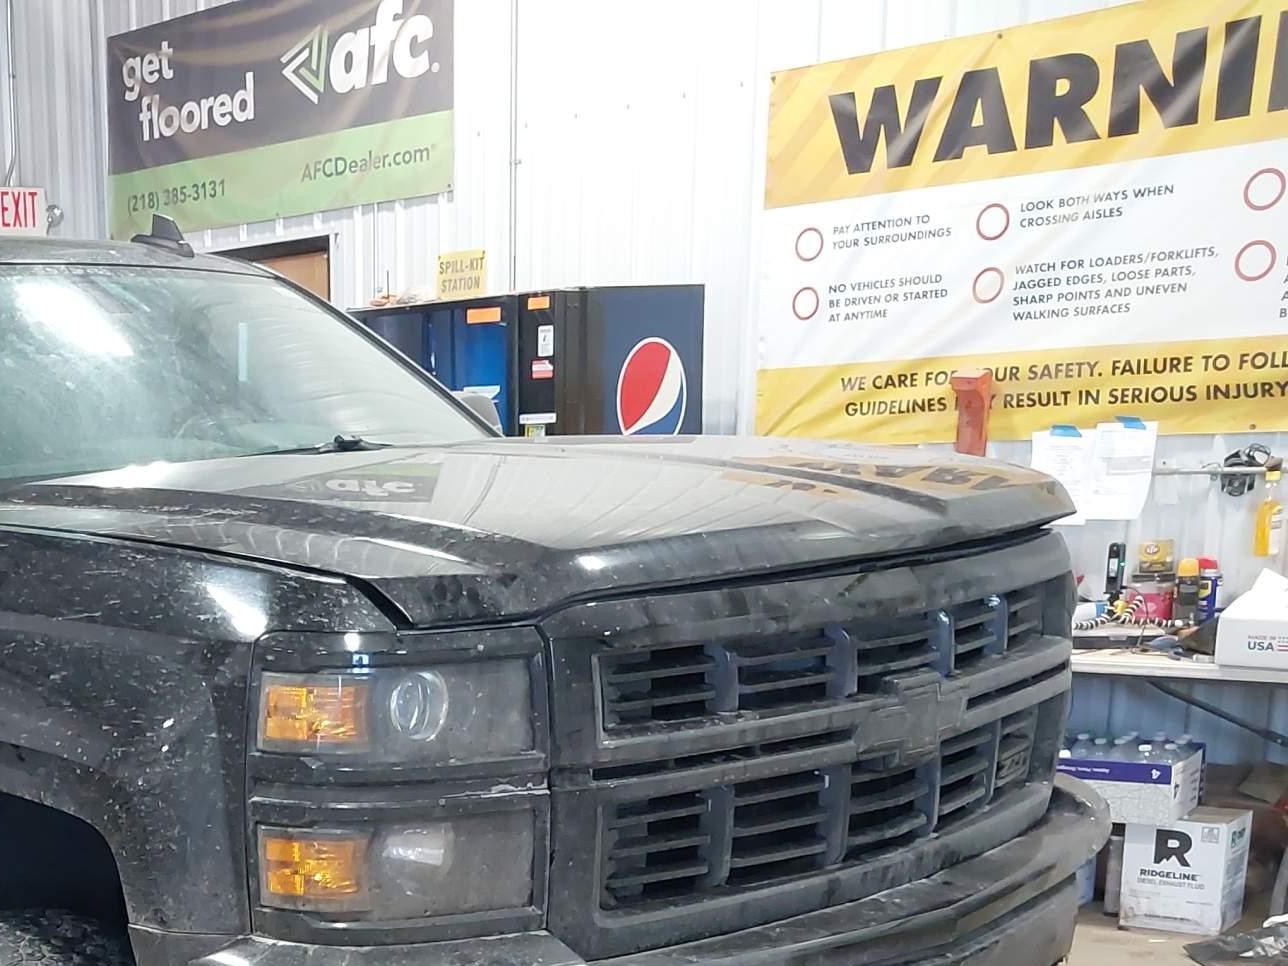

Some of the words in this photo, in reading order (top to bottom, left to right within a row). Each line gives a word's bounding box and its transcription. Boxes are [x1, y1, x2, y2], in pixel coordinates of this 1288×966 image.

[122, 41, 173, 101] get
[828, 10, 1288, 175] WARNI
[139, 72, 255, 141] floored
[301, 146, 430, 182] AFCDealer.com
[0, 191, 38, 228] EXIT
[127, 191, 160, 216] (218)
[163, 179, 226, 206] 385-3131
[1020, 199, 1054, 213] LOOK
[1058, 195, 1090, 209] BOTH
[1093, 189, 1129, 203] WAYS
[1133, 184, 1175, 199] WHEN
[833, 224, 851, 236] PAY
[853, 216, 913, 233] ATTENTION
[916, 214, 931, 225] TO
[1019, 211, 1079, 229] CROSSING
[1082, 206, 1124, 221] AISLES
[832, 238, 860, 250] YOUR
[863, 227, 952, 247] SURROUNDINGS
[1015, 261, 1057, 275] WATCH
[1060, 258, 1085, 270] FOR
[1089, 246, 1219, 269] LOADERS/FORKLIFTS,
[441, 276, 481, 292] STATION
[828, 284, 847, 295] NO
[850, 278, 895, 292] VEHICLES
[898, 273, 943, 287] SHOULD
[1012, 277, 1062, 291] JAGGED
[1065, 273, 1107, 286] EDGES,
[1111, 268, 1151, 283] LOOSE
[1154, 265, 1196, 279] PARTS,
[828, 298, 841, 309] BE
[844, 295, 881, 307] DRIVEN
[884, 292, 900, 304] OR
[903, 288, 948, 302] STARTED
[1012, 294, 1053, 306] SHARP
[1057, 290, 1101, 303] POINTS
[1104, 287, 1132, 299] AND
[1136, 282, 1187, 297] UNEVEN
[828, 313, 842, 323] AT
[843, 308, 888, 322] ANYTIME
[1012, 307, 1070, 321] WALKING
[1073, 302, 1131, 317] SURFACES
[841, 376, 867, 392] WE
[872, 372, 918, 390] CARE
[1027, 360, 1103, 382] SAFETY.
[1111, 356, 1194, 377] FAILURE
[1201, 354, 1231, 372] TO
[844, 396, 948, 417] GUIDELINES
[1003, 390, 1072, 409] RESULT
[1078, 389, 1101, 405] IN
[1107, 385, 1199, 405] SERIOUS
[1206, 381, 1288, 400] INJURY
[1248, 641, 1274, 651] USA
[1153, 828, 1192, 867] R
[1139, 868, 1199, 882] RIDGELINE
